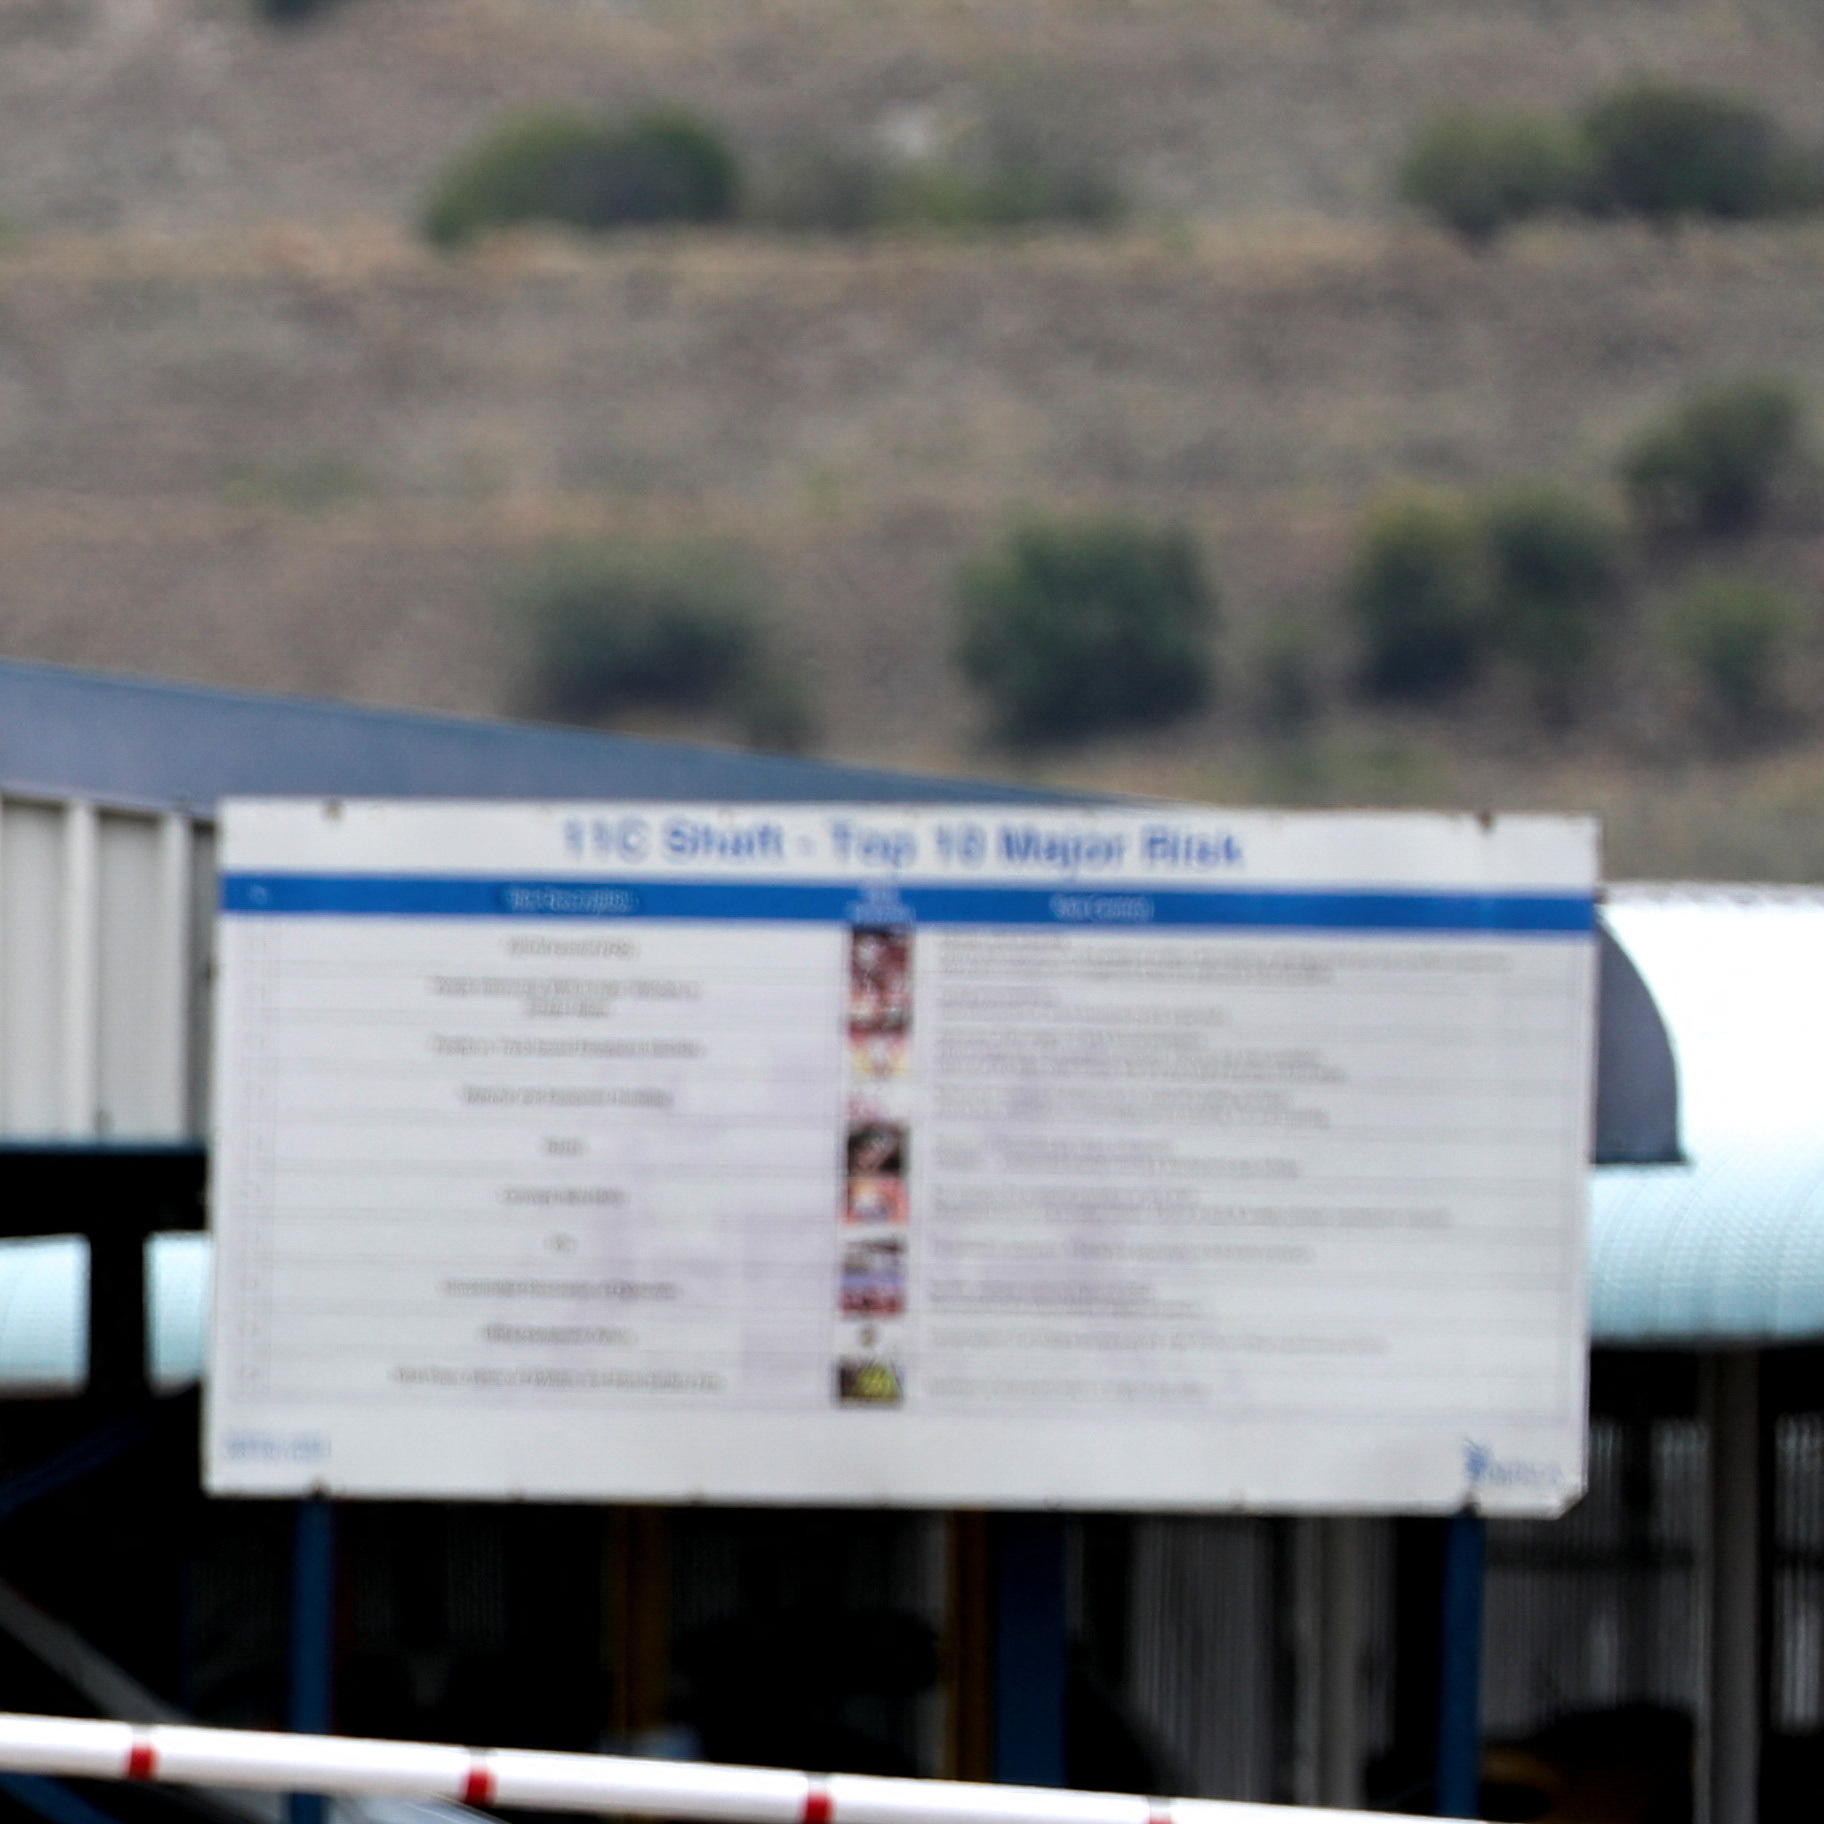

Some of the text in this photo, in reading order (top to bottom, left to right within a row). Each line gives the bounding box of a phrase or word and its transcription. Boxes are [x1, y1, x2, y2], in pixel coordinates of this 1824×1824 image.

[563, 820, 648, 862] 11C
[663, 820, 784, 861] Shaft
[832, 825, 914, 872] Top
[935, 826, 985, 867] 10
[1001, 828, 1125, 879] Major
[1141, 832, 1244, 868] Risk
